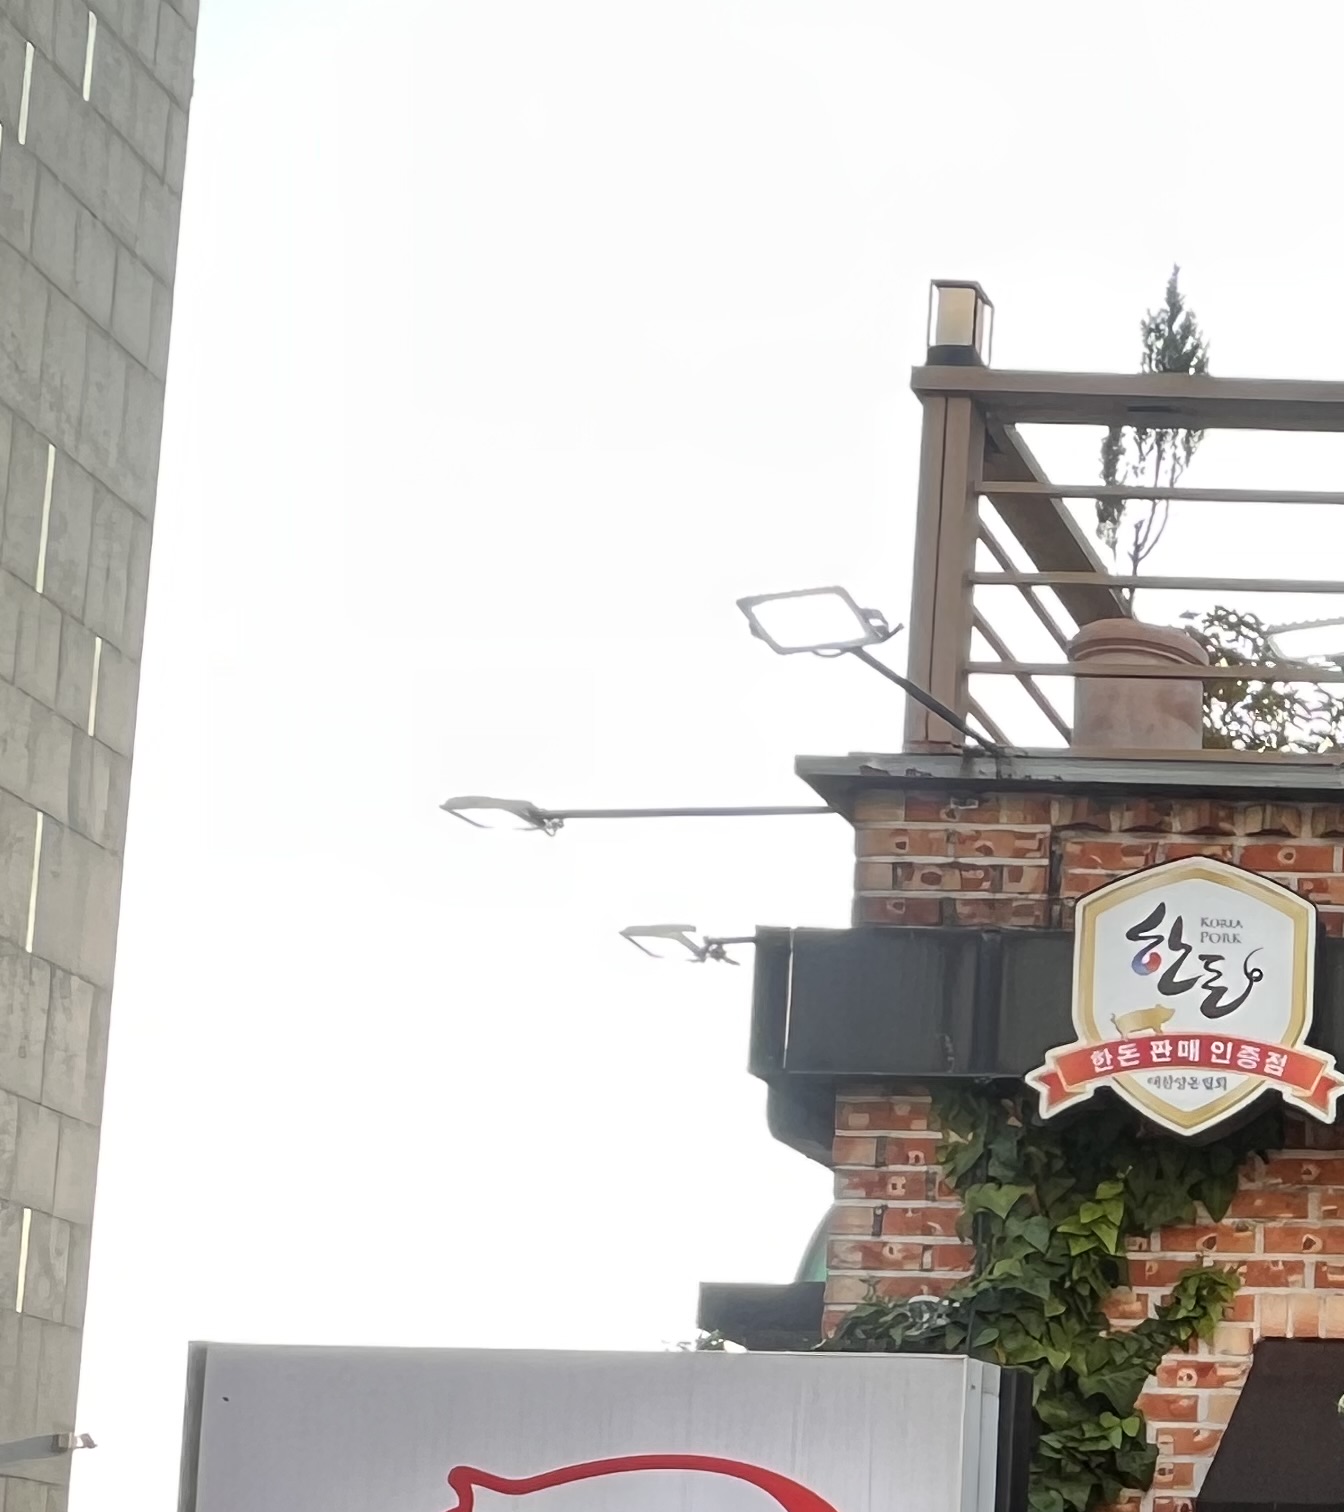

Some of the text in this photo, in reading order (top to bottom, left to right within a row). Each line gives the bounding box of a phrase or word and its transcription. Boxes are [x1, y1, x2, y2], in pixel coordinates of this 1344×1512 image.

[1200, 931, 1242, 944] PORK
[1090, 1037, 1288, 1077] 한돈 판매 인증점
